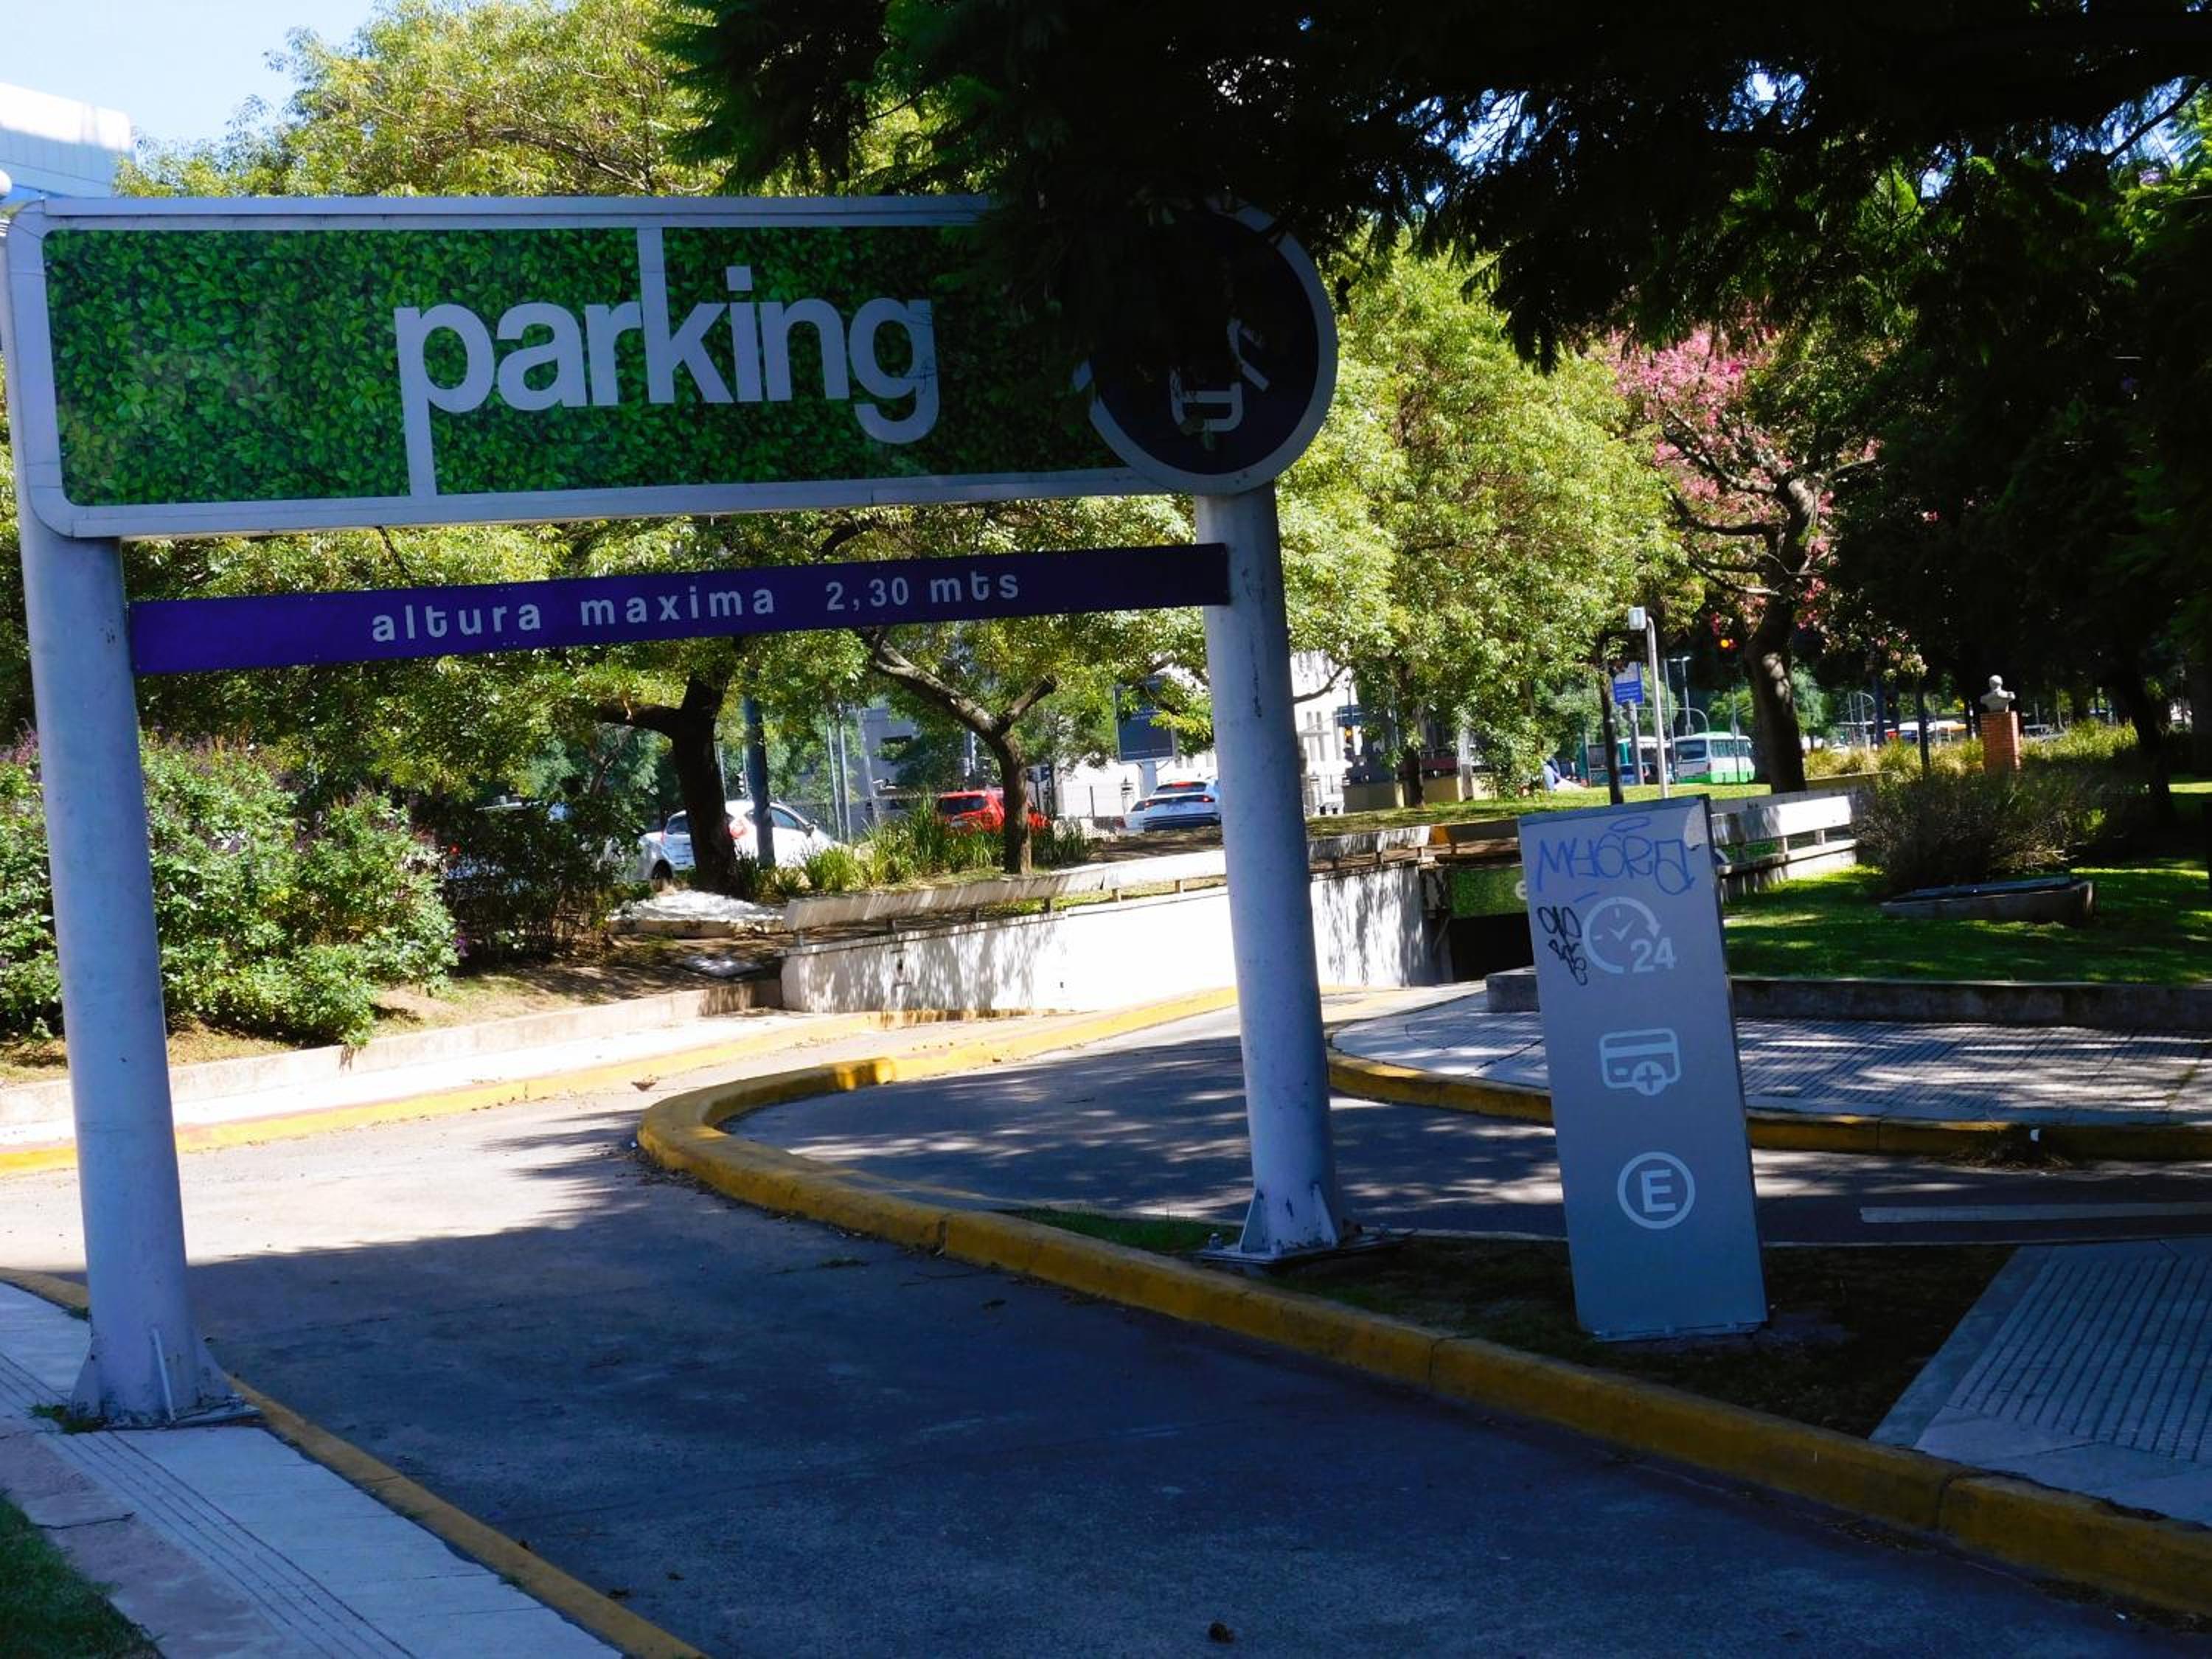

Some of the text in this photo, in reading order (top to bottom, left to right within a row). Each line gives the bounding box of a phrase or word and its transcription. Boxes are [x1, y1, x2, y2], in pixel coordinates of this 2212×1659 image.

[393, 227, 941, 495] parking
[372, 569, 1019, 643] altura maxima 2,30 mts
[1630, 936, 1677, 974] 24
[1640, 1168, 1677, 1214] E
